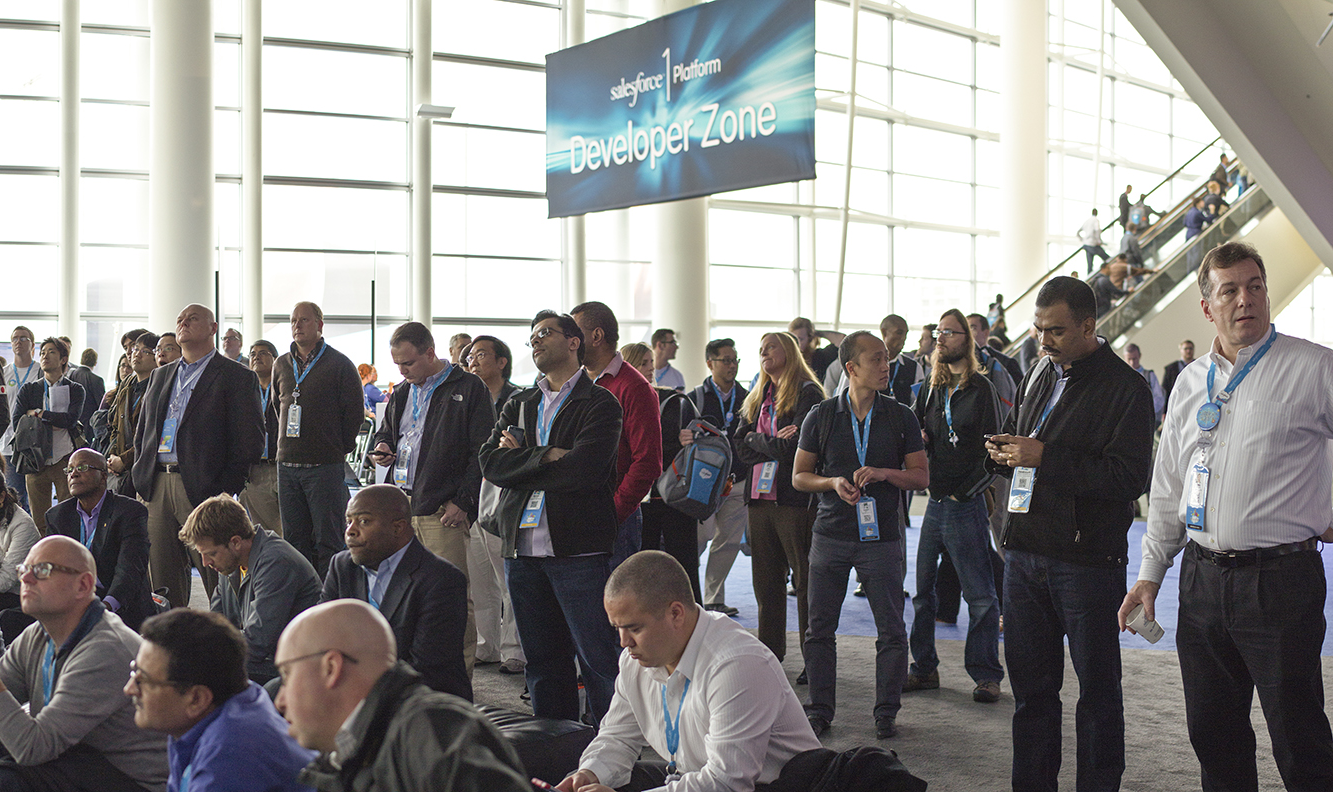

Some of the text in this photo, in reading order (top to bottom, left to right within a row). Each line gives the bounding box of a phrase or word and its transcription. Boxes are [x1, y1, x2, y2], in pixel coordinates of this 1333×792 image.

[610, 72, 663, 107] salesforce
[673, 58, 721, 84] Platform
[570, 102, 777, 175] Developer Zone
